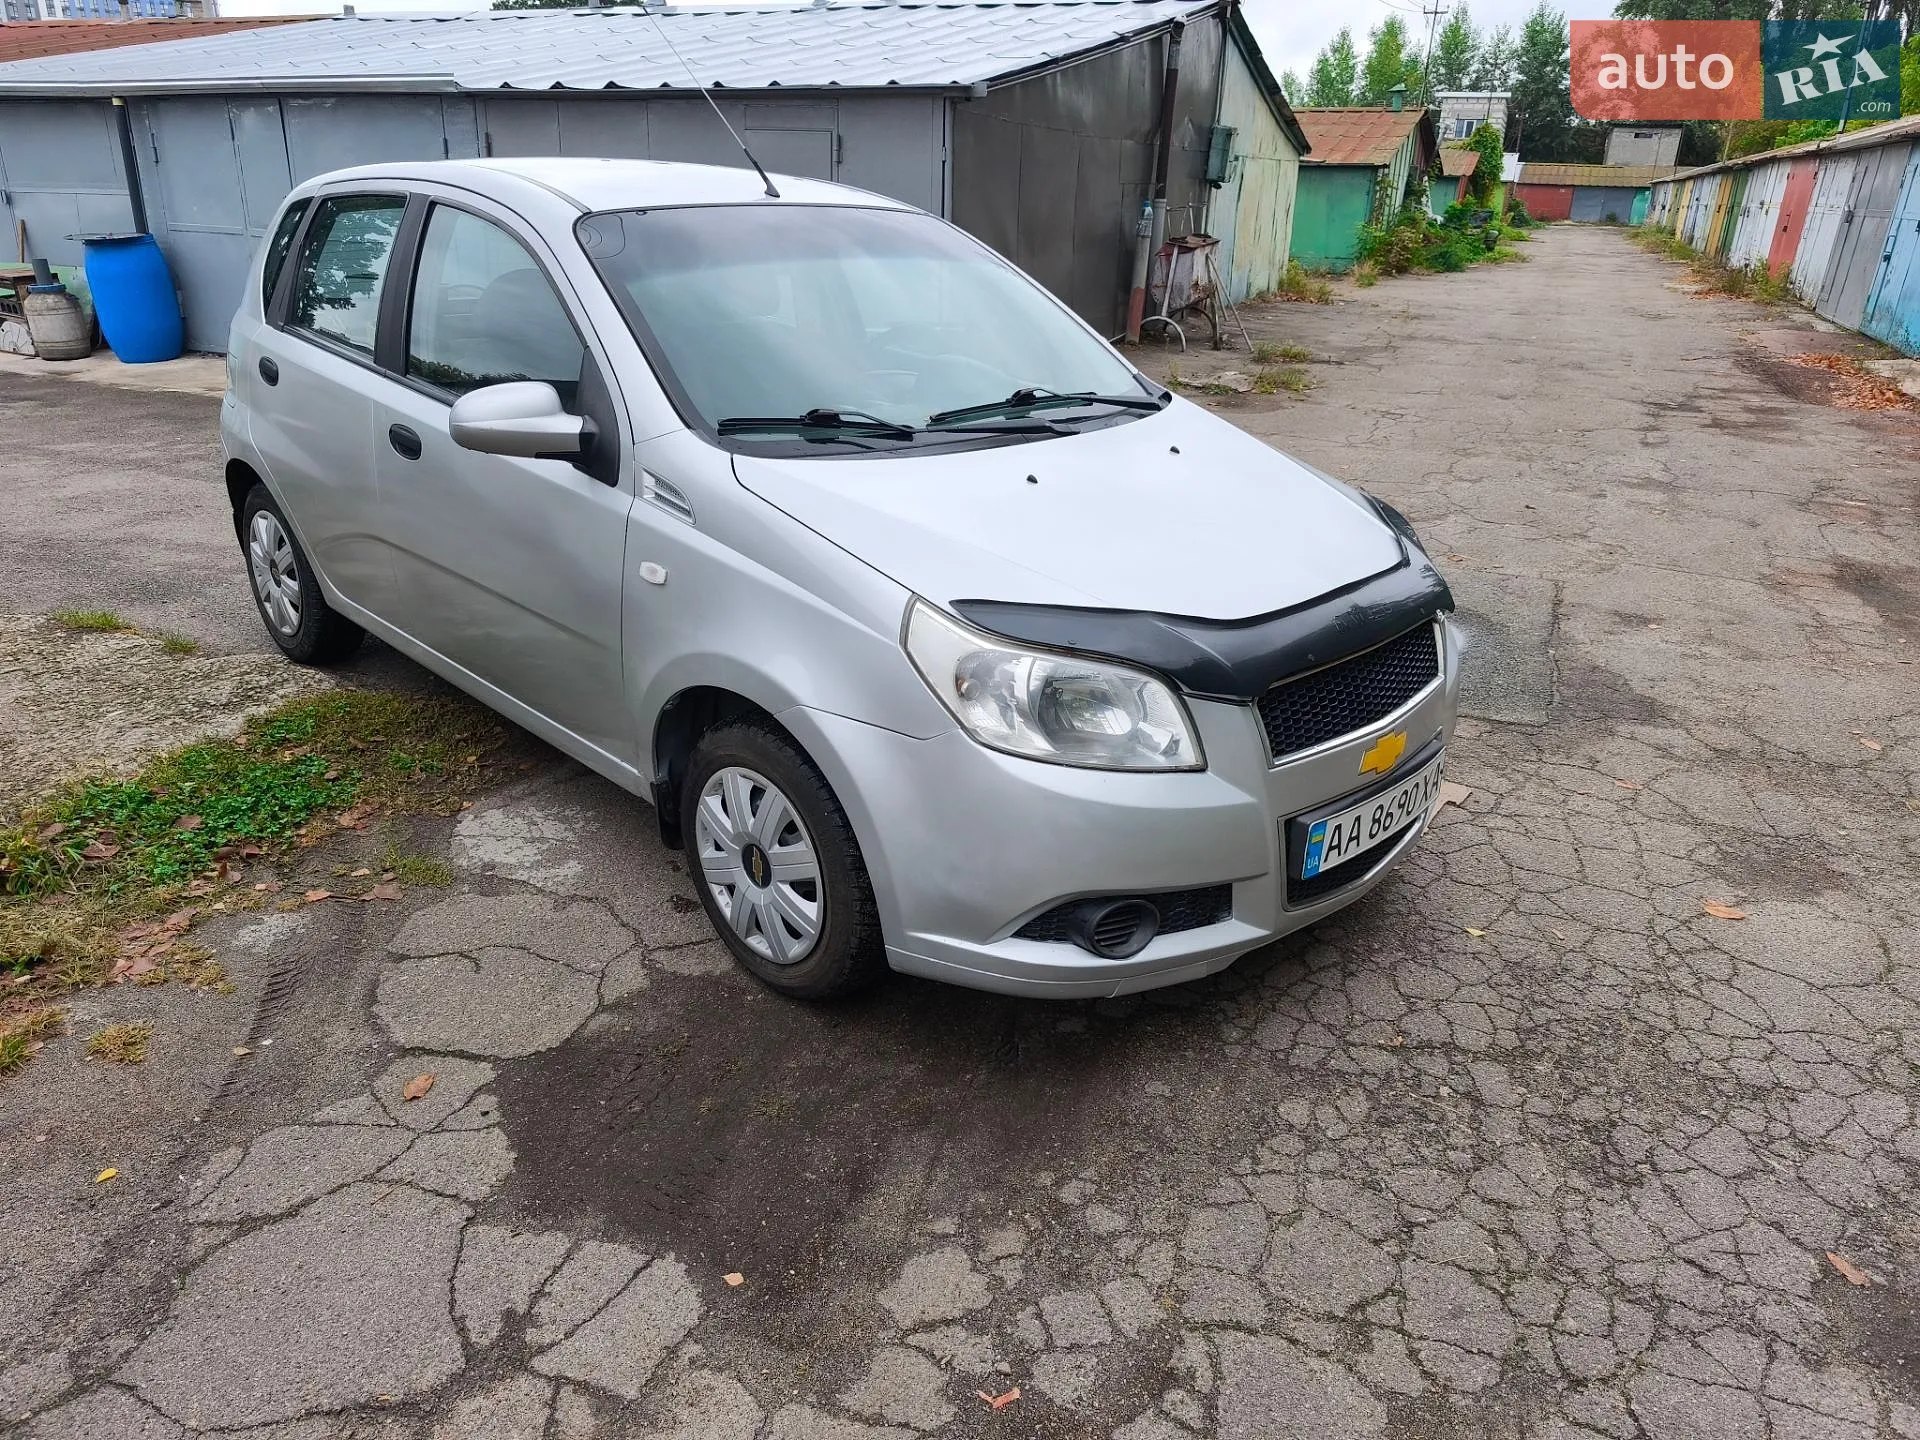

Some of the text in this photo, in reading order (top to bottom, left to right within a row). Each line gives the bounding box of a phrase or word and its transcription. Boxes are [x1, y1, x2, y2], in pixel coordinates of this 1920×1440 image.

[1324, 814, 1361, 863] AA
[1368, 782, 1420, 840] 8690
[1307, 856, 1320, 869] UA
